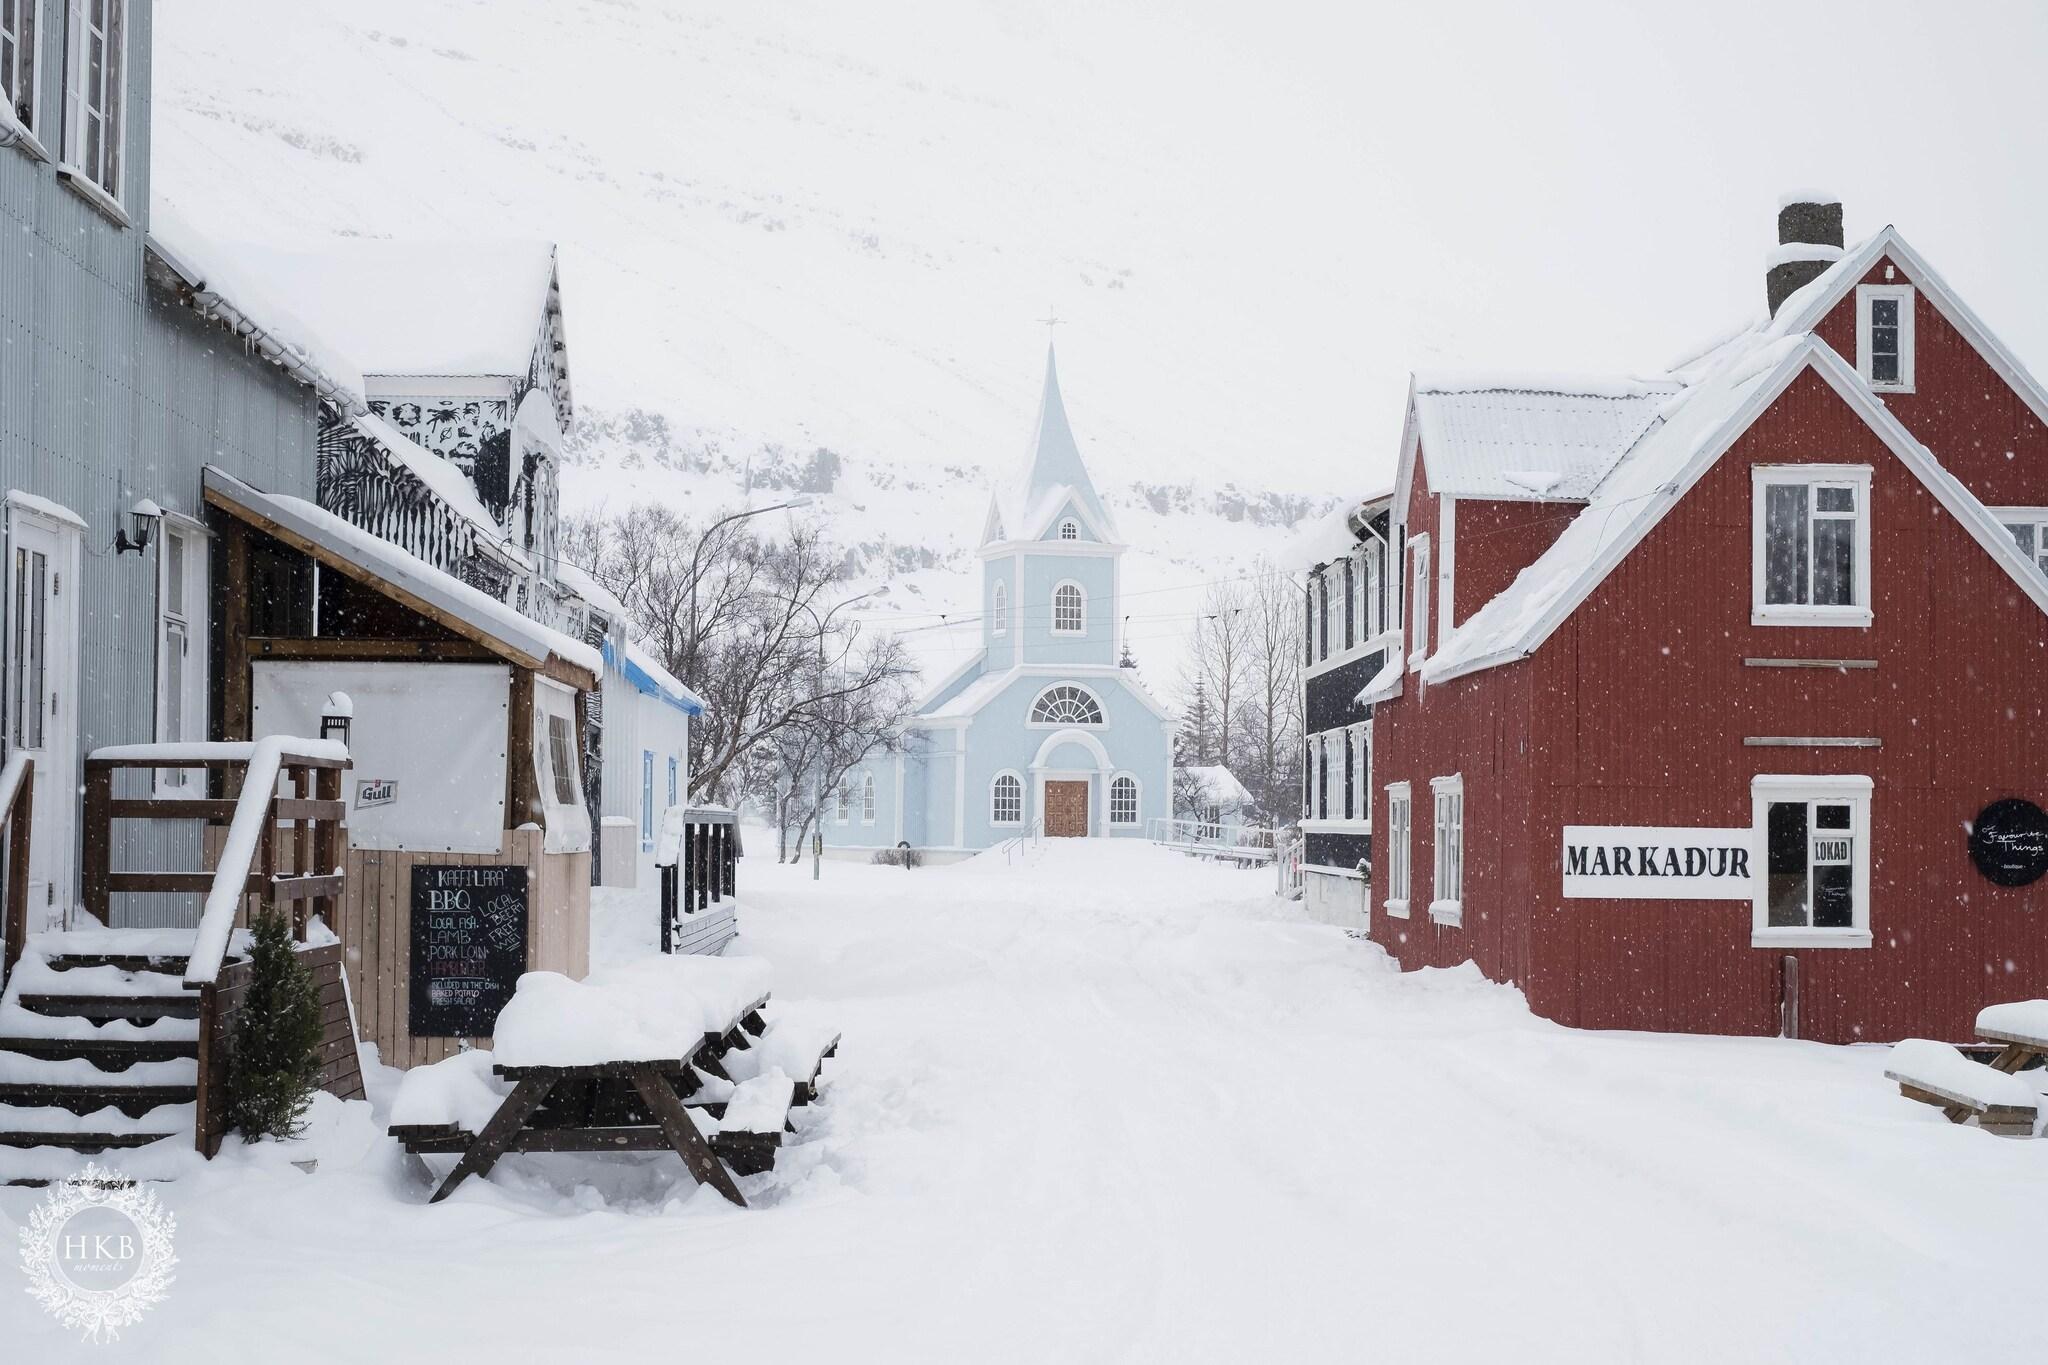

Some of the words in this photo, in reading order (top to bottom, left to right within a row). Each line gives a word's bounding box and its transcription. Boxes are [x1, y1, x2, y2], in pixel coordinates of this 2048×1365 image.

[362, 785, 391, 800] Gull
[1996, 840, 2043, 856] Things
[474, 870, 504, 886] LARA
[426, 889, 470, 910] BBQ
[478, 893, 520, 917] LOCAL
[429, 914, 456, 929] LOCAL
[430, 930, 471, 944] LAMB
[489, 919, 517, 942] FREE
[428, 945, 458, 960] PORK
[461, 945, 487, 959] LOIN
